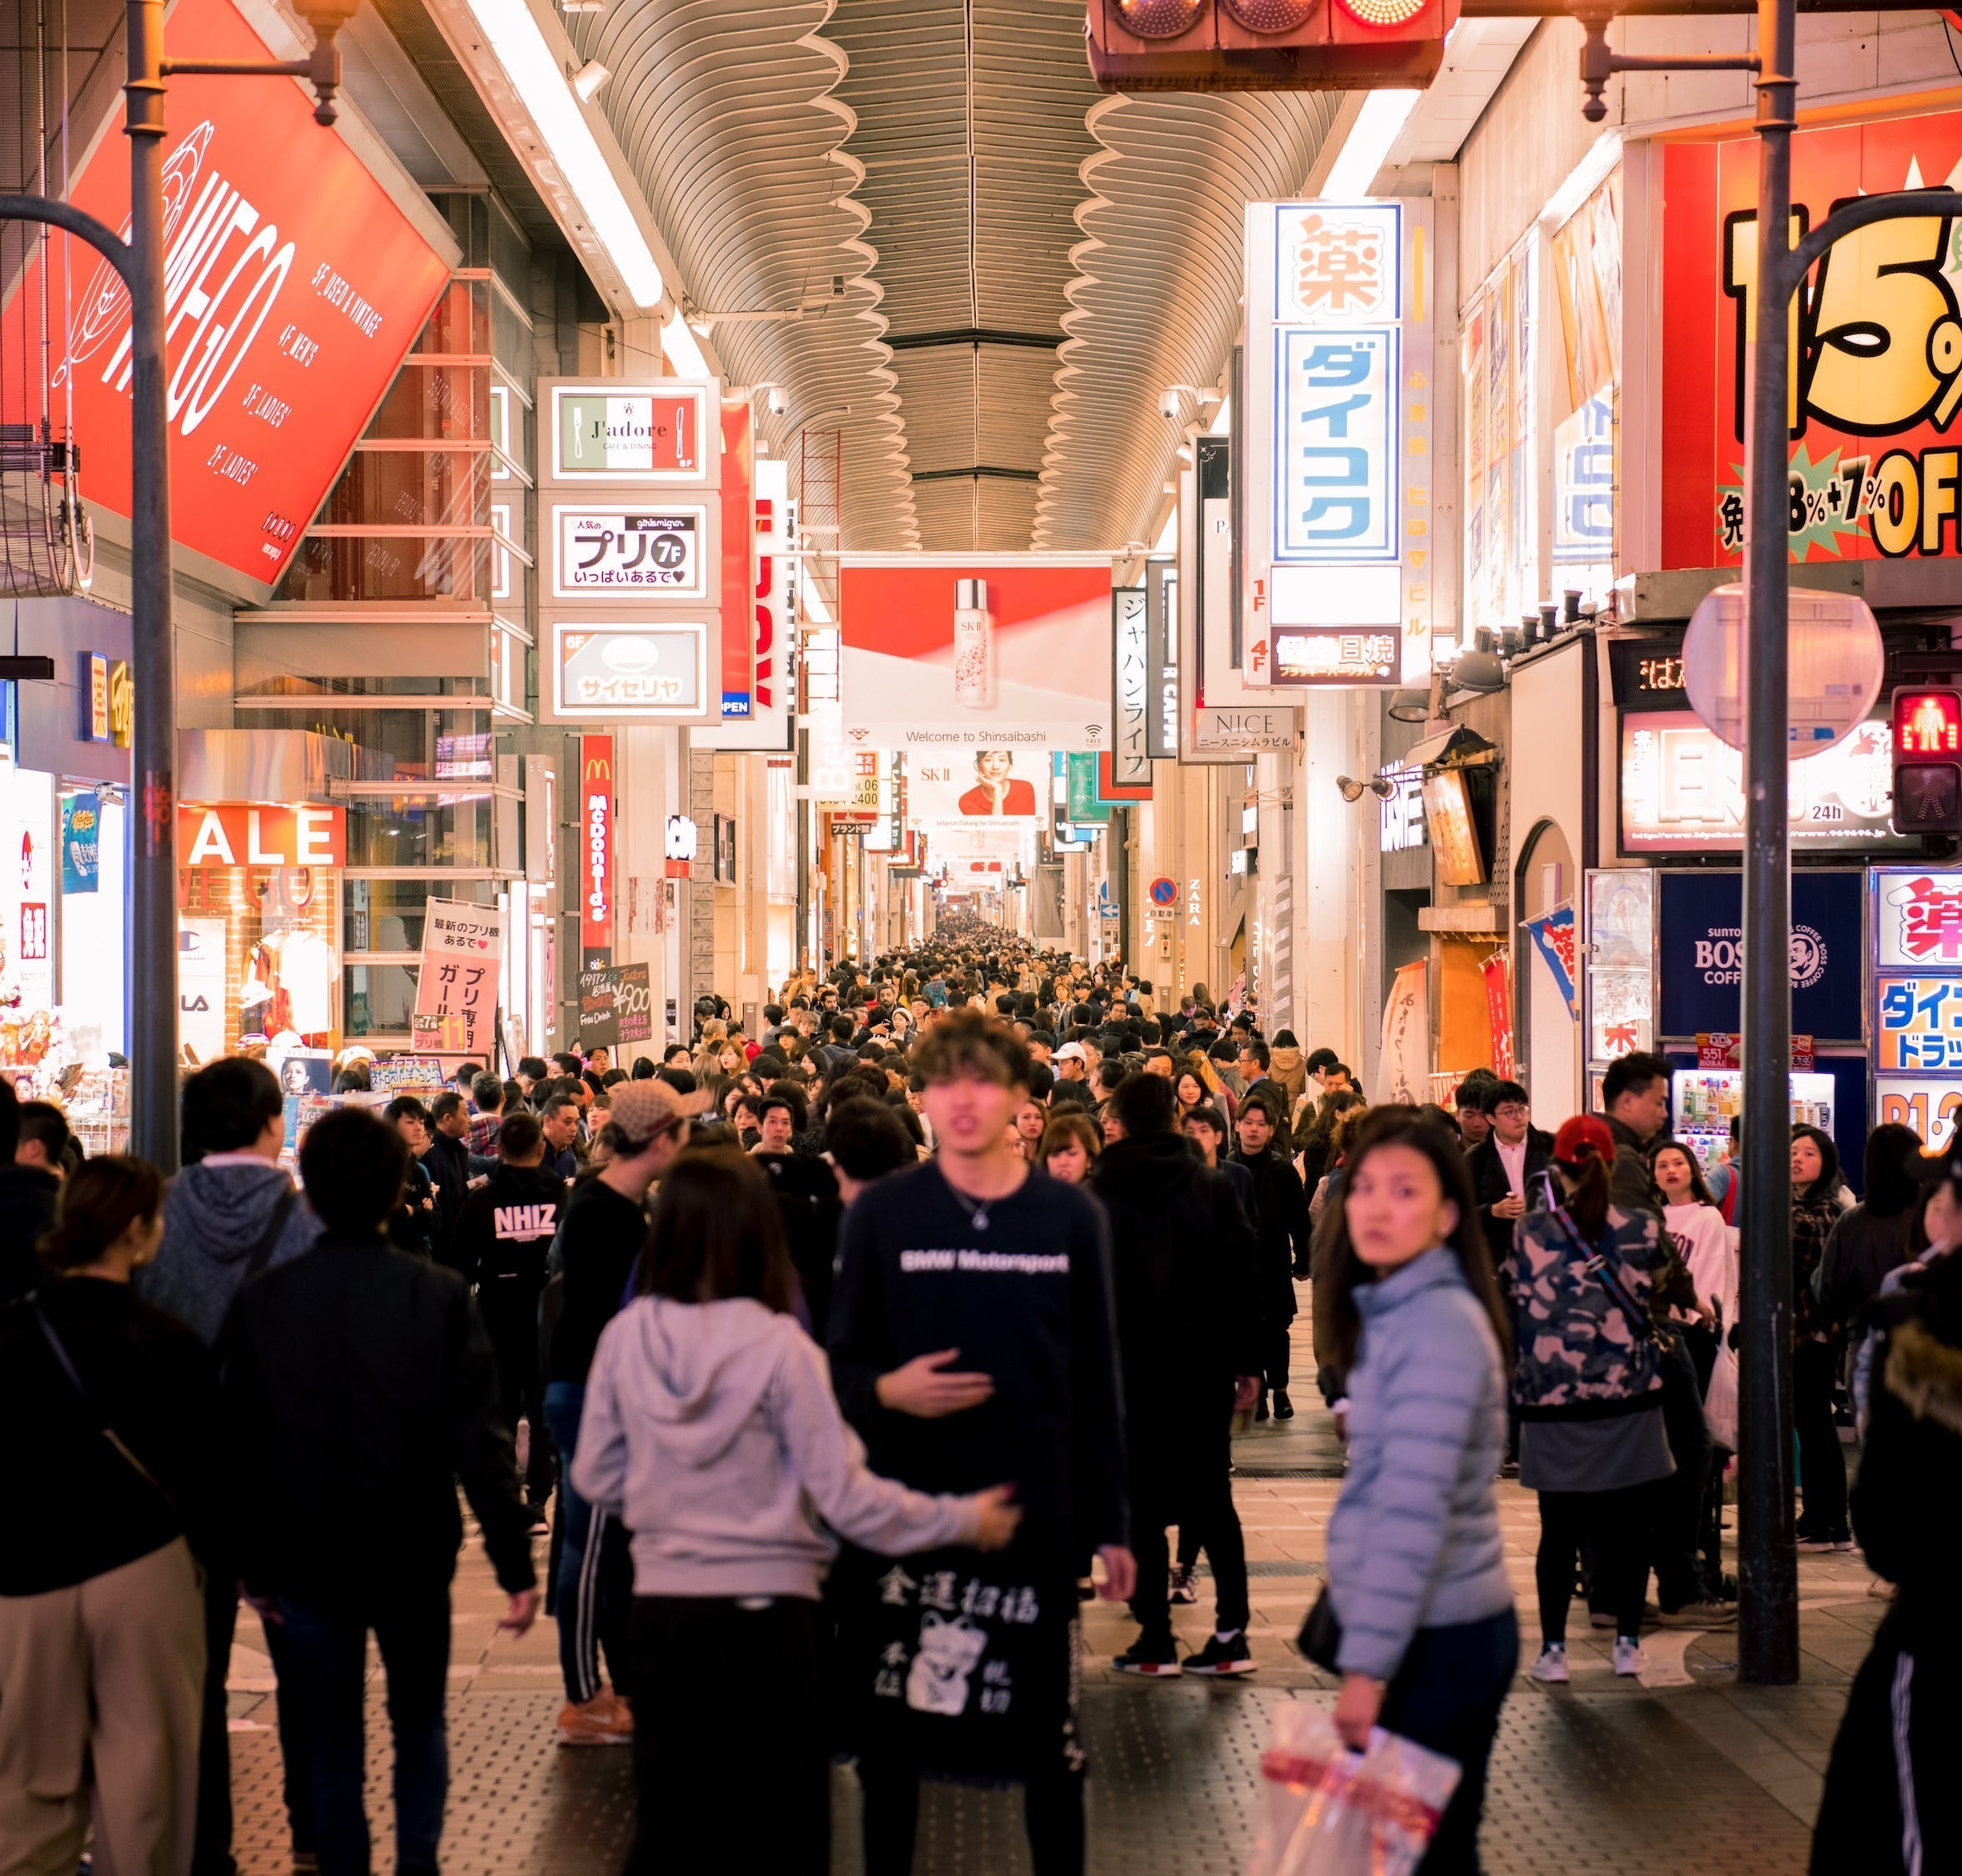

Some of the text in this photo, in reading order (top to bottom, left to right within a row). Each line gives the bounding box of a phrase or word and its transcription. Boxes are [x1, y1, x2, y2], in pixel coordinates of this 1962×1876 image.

[1299, 213, 1378, 309] 薬
[349, 294, 384, 339] VINTAGE
[591, 420, 668, 439] J'adore
[1300, 341, 1377, 539] ダイコク
[679, 459, 693, 468] 8F
[1719, 456, 1886, 550] 免8%+7%
[1872, 448, 1962, 558] OF
[576, 521, 601, 530] 人気の
[575, 529, 681, 570] プリ 7F
[574, 570, 671, 584] いっぱいあるで
[1253, 579, 1266, 611] 1F
[565, 635, 585, 648] 6F
[1251, 640, 1269, 672] 4F
[721, 702, 748, 713] PEN
[1216, 715, 1275, 734] NICE
[906, 730, 1046, 743] Welcome to Shinsaibashi
[865, 780, 878, 791] 06
[1812, 805, 1842, 820] 24h
[188, 810, 334, 864] ALE
[832, 825, 871, 834] ブランド館
[588, 795, 609, 923] McDonald's
[1187, 879, 1202, 925] ZARA
[434, 918, 500, 938] 最新のプリ機
[1708, 928, 1742, 937] SUNTO
[1795, 925, 1823, 943] COFFEE
[444, 935, 477, 948] あるで
[1695, 941, 1743, 969] BOS
[1819, 943, 1828, 966] BOSS
[1704, 971, 1741, 985] COFF
[181, 995, 209, 1011] LA
[612, 982, 650, 1016] ¥900
[423, 1016, 432, 1029] 7
[580, 1011, 611, 1026] Free Drink
[439, 1016, 464, 1050] 11
[1703, 1047, 1722, 1060] 551
[1899, 1034, 1962, 1068] ドラッ
[494, 1203, 557, 1232] NHIZ
[901, 1249, 1070, 1274] BMW Motorsport
